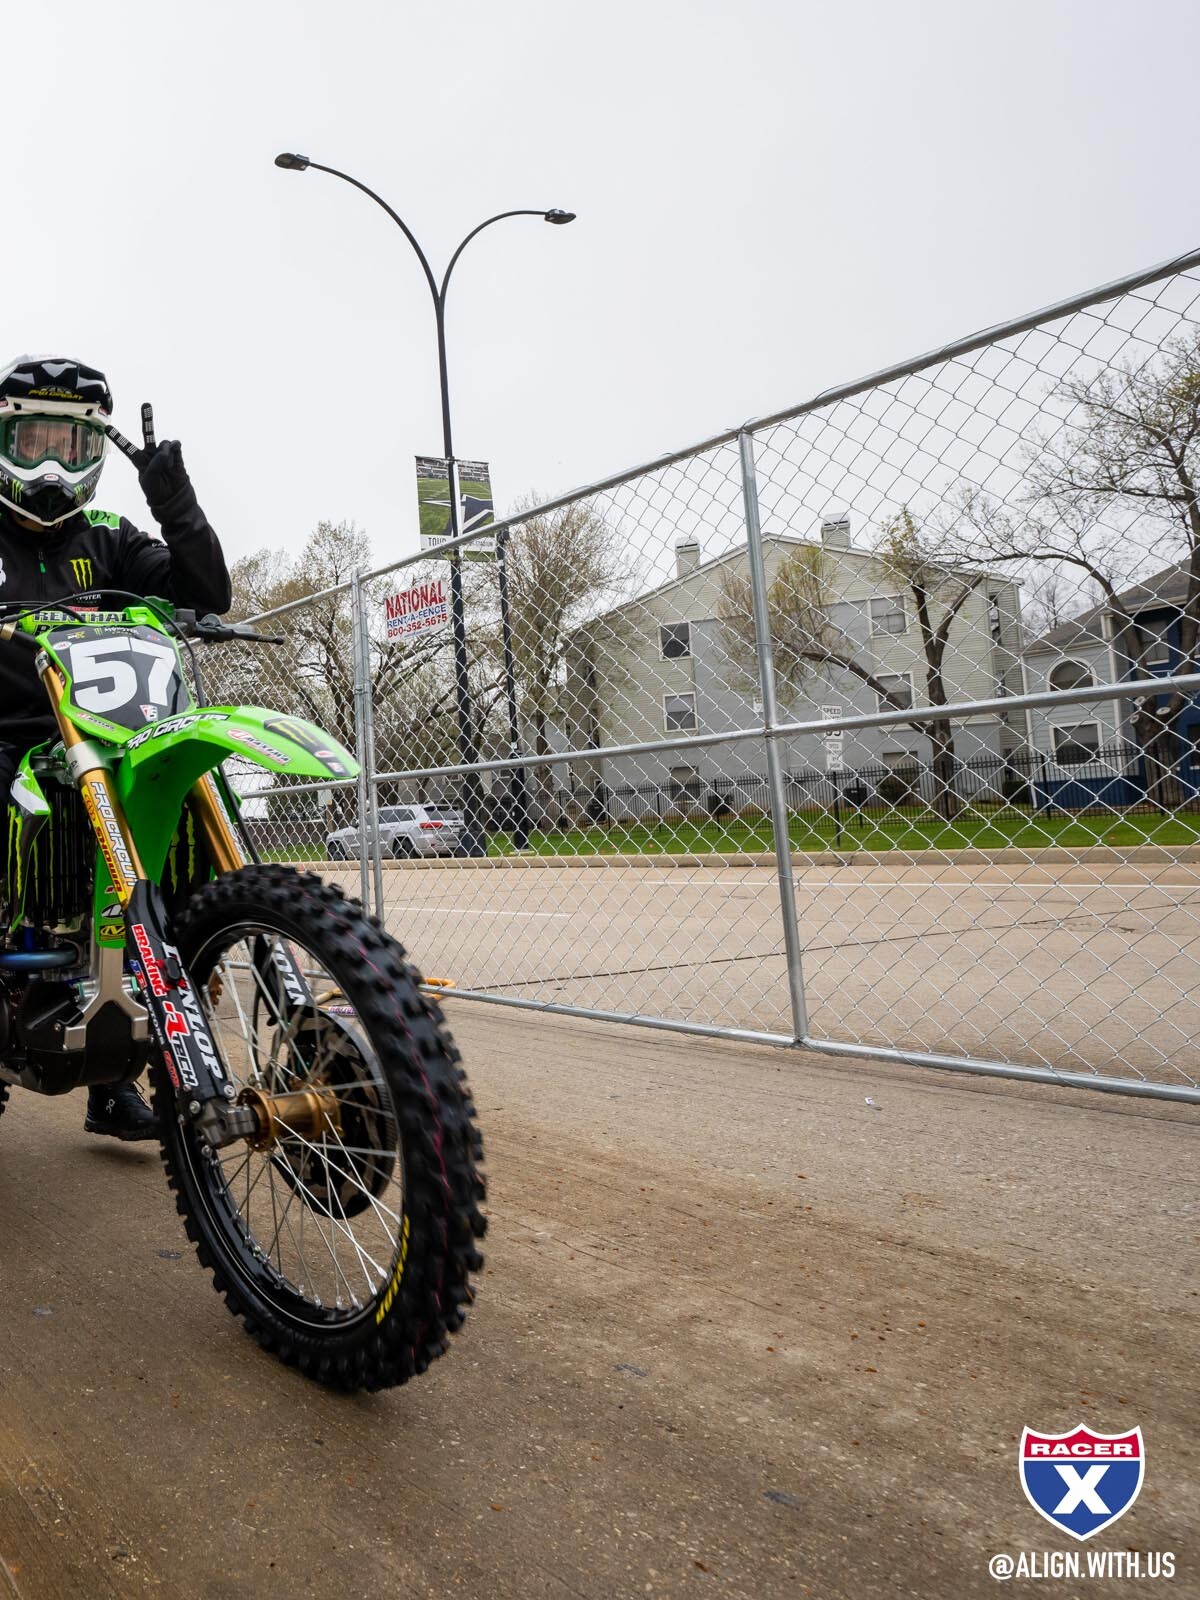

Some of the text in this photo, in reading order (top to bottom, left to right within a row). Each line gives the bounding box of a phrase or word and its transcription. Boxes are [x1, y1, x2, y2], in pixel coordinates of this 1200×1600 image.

[90, 509, 110, 522] OX
[33, 612, 131, 622] RENTHAL
[385, 581, 446, 620] NATIONAL
[387, 605, 447, 628] RENT-A-FENCE
[388, 613, 448, 638] 800-352-5675
[70, 637, 176, 712] 57
[90, 782, 115, 820] PRO
[131, 924, 167, 997] BRAKING
[162, 941, 224, 1080] DNLOP
